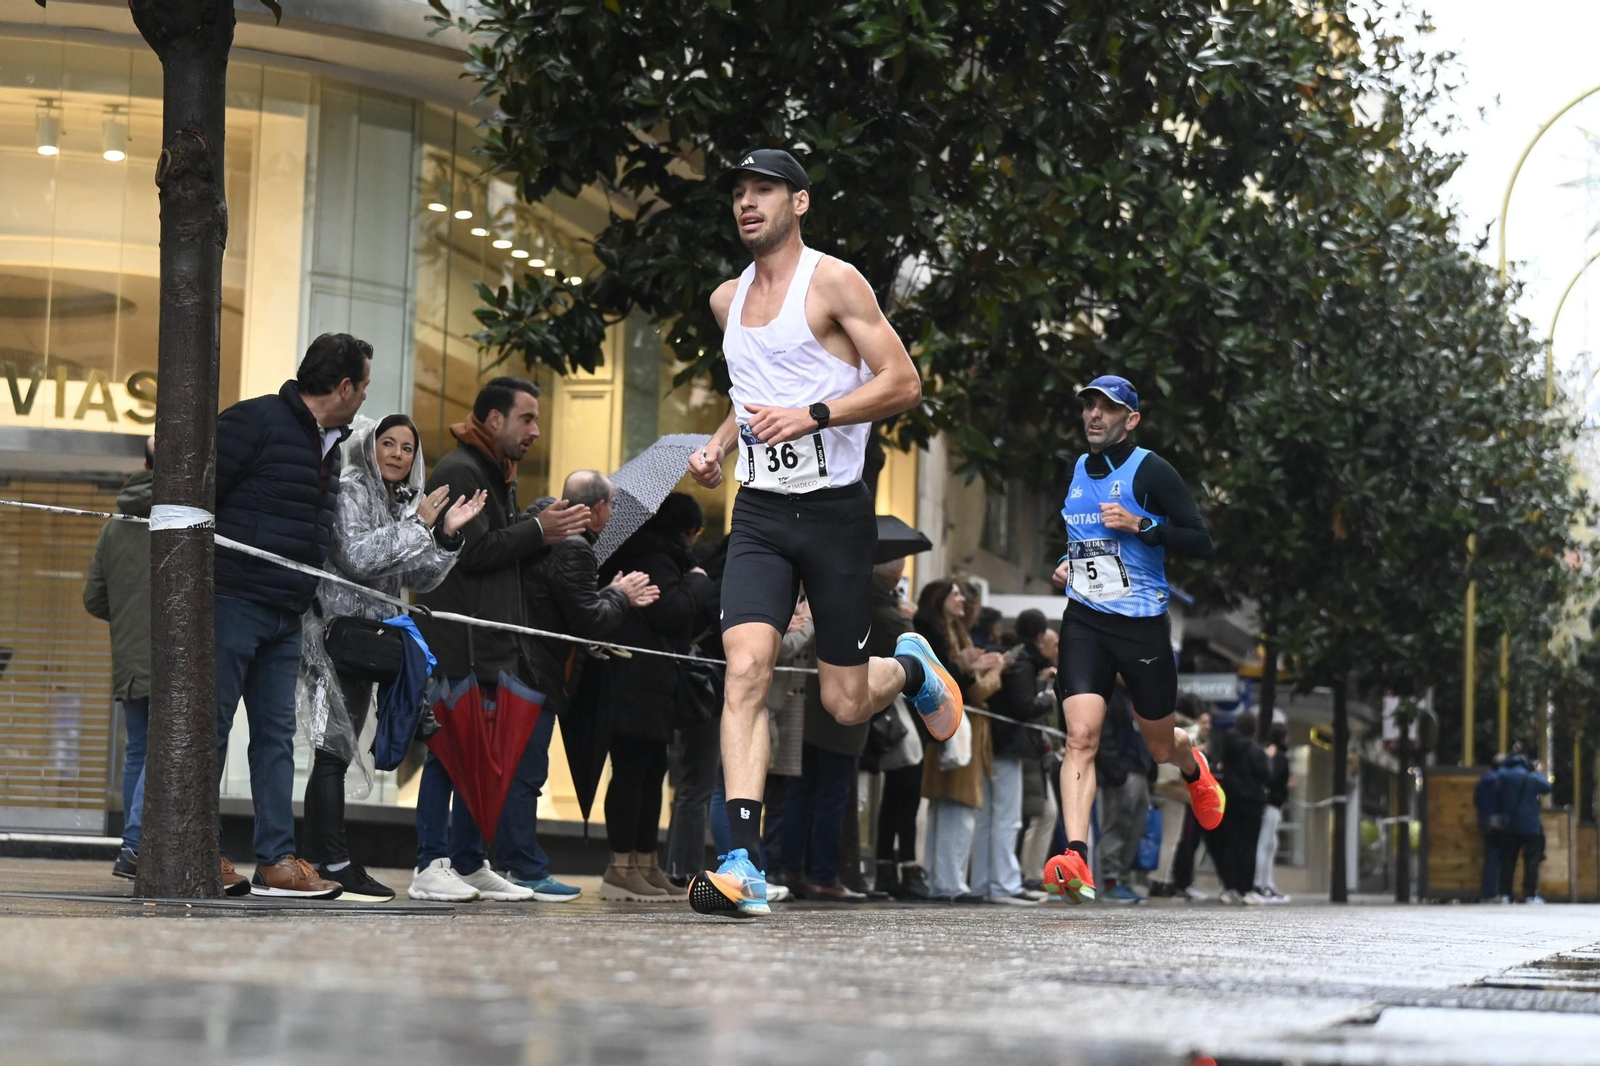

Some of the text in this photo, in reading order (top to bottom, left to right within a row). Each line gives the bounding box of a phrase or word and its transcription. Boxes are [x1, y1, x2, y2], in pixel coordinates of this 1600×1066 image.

[3, 361, 157, 425] VIAS
[766, 443, 799, 472] 36
[1085, 560, 1098, 580] 5
